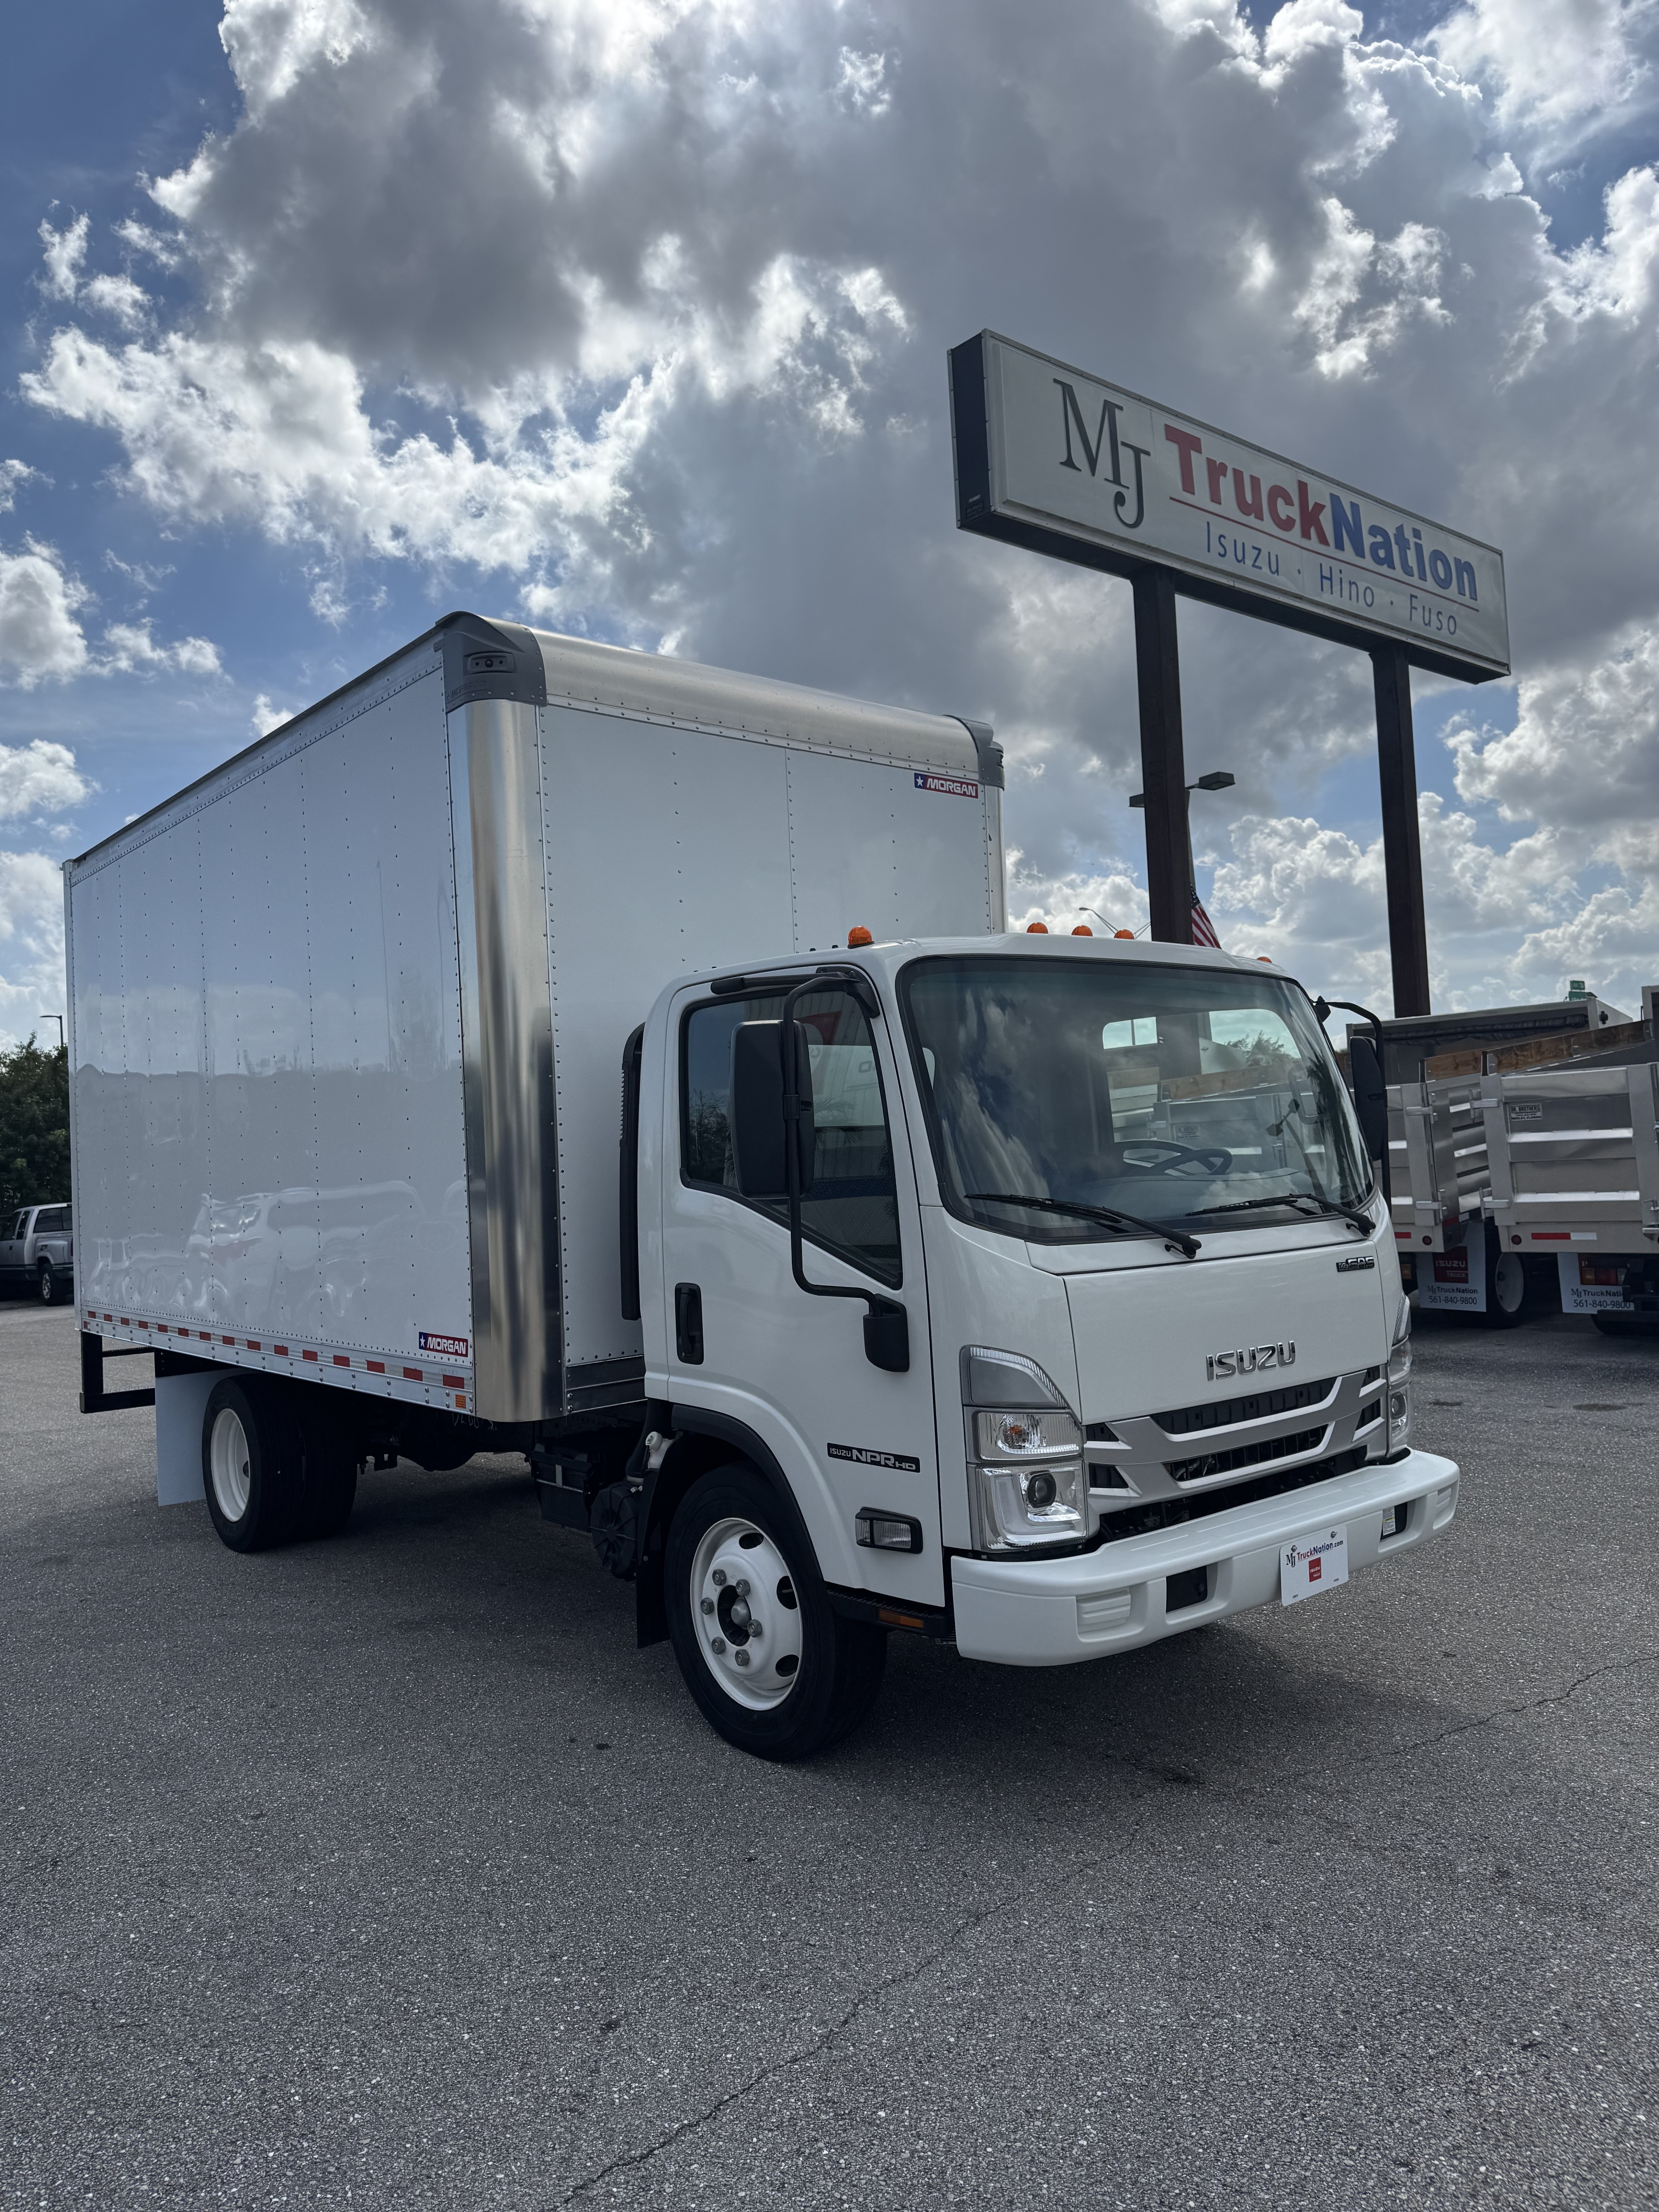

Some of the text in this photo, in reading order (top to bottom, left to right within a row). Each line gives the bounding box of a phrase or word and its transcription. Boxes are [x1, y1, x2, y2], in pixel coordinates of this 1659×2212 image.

[1053, 378, 1478, 601] MJ TruckNation
[1206, 521, 1457, 635] Isuzu Hino Fuso
[926, 778, 976, 796] MORGAN
[1429, 1295, 1477, 1305] 561-840-9800
[1573, 1299, 1630, 1309] 561-840-9800
[427, 1336, 466, 1354] MORGAN
[1206, 1340, 1296, 1382] ISUZU
[830, 1448, 851, 1457] ISUZU
[1297, 1540, 1343, 1561] TruckNation.com
